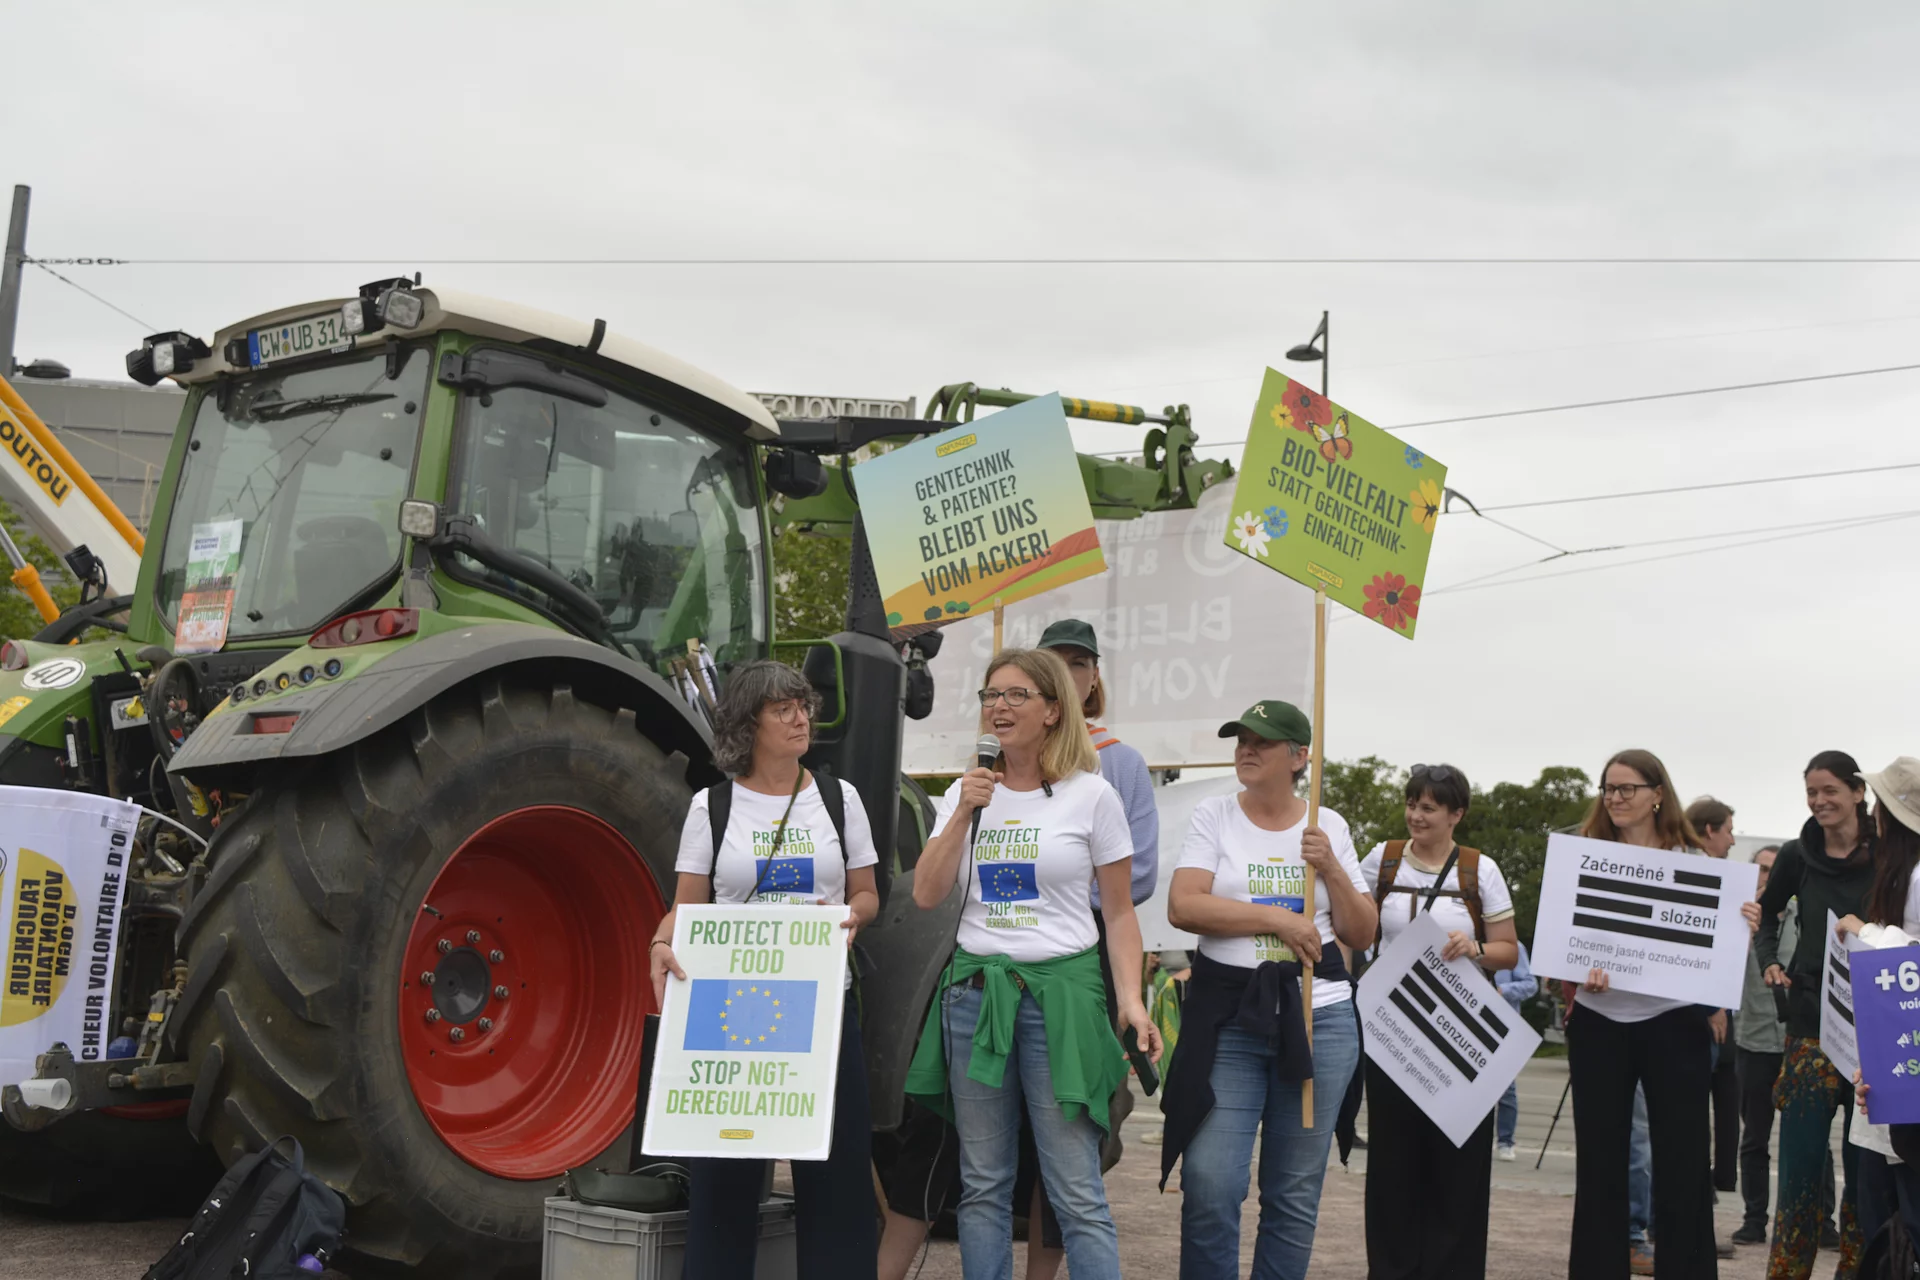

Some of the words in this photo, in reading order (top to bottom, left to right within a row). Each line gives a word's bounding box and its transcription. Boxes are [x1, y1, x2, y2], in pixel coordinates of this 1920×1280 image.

[259, 330, 280, 359] CW
[291, 324, 313, 351] UB
[915, 448, 1014, 501] GENTECHNIK
[1281, 438, 1408, 528] BIO-VIELFALT
[923, 505, 938, 526] &
[942, 474, 1017, 520] PATENTE?
[1268, 466, 1311, 504] STATT
[1315, 491, 1406, 554] GENTECHNIK-
[919, 517, 987, 562] BLEIBT
[993, 498, 1037, 536] UNS
[1303, 513, 1364, 561] EINFALT!
[921, 557, 972, 597] VOM
[977, 529, 1052, 579] ACKER!
[31, 662, 75, 685] 40
[1252, 704, 1268, 718] R
[752, 828, 812, 844] PROTECT
[783, 842, 815, 855] FOOD
[977, 828, 1041, 844] PROTECT
[975, 845, 1000, 860] OUR
[1005, 844, 1039, 859] FOOD
[1247, 863, 1306, 879] PROTECT
[1580, 855, 1664, 881] Začerněné
[757, 892, 787, 903] STOP
[1249, 880, 1274, 894] OUR
[88, 873, 120, 990] VOLONTAIRE
[108, 829, 128, 868] D'O
[986, 916, 1038, 928] DEREGULATION
[1660, 908, 1717, 930] složení
[689, 920, 783, 946] PROTECT
[789, 920, 832, 946] OUR
[729, 948, 784, 974] FOOD
[1567, 952, 1590, 967] GMO
[1593, 958, 1642, 976] potravin!
[1569, 936, 1613, 954] Chceme
[1615, 944, 1645, 959] jasné
[1648, 952, 1711, 970] označování
[1423, 945, 1478, 1009] Ingrediente
[1899, 997, 1920, 1011] voi
[1436, 1014, 1487, 1068] cenzurate
[1365, 1020, 1406, 1064] modificate
[1406, 1061, 1440, 1096] genetic!
[1412, 1044, 1452, 1088] alimentele
[1907, 1058, 1920, 1076] S
[689, 1060, 741, 1085] STOP
[747, 1061, 798, 1086] NGT-
[666, 1089, 816, 1117] DEREGULATION
